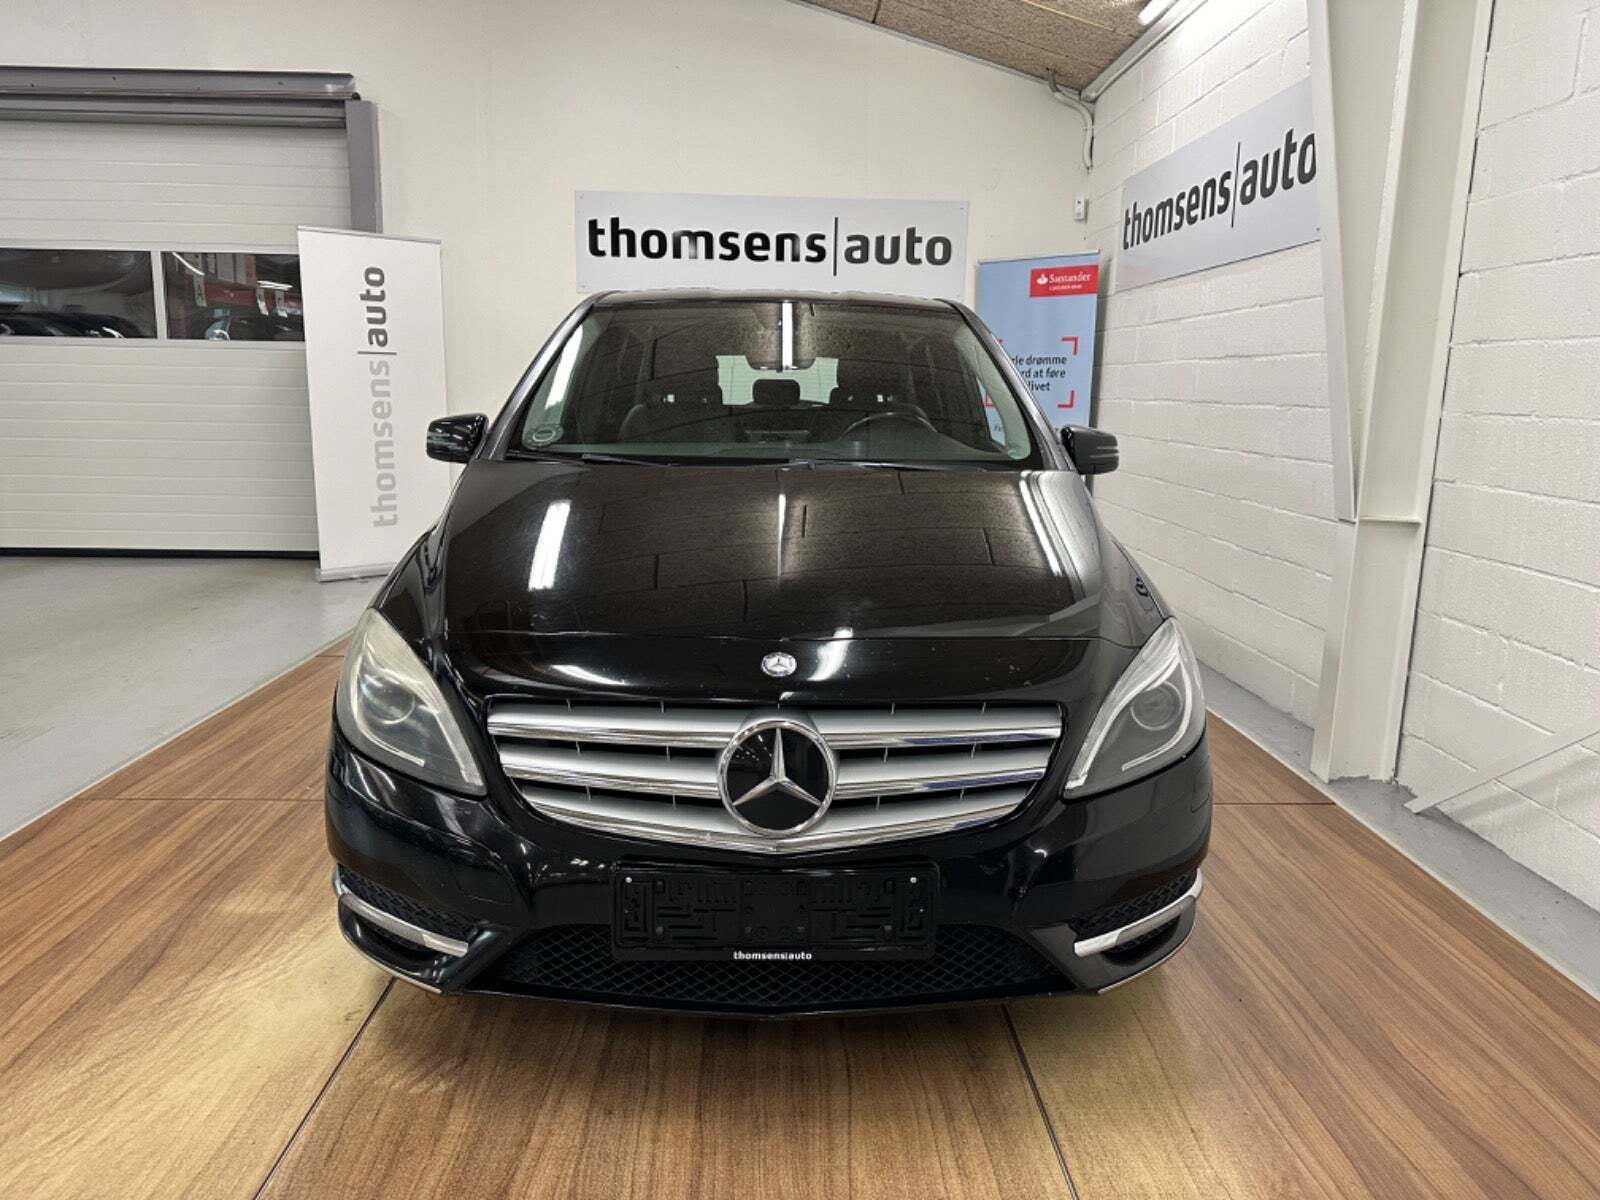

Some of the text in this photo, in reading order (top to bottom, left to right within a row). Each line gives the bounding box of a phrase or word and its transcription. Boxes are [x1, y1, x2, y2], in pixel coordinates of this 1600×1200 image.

[1048, 271, 1092, 284] Santander
[1025, 354, 1068, 366] drømme
[1033, 369, 1044, 378] at
[1046, 367, 1066, 378] føre
